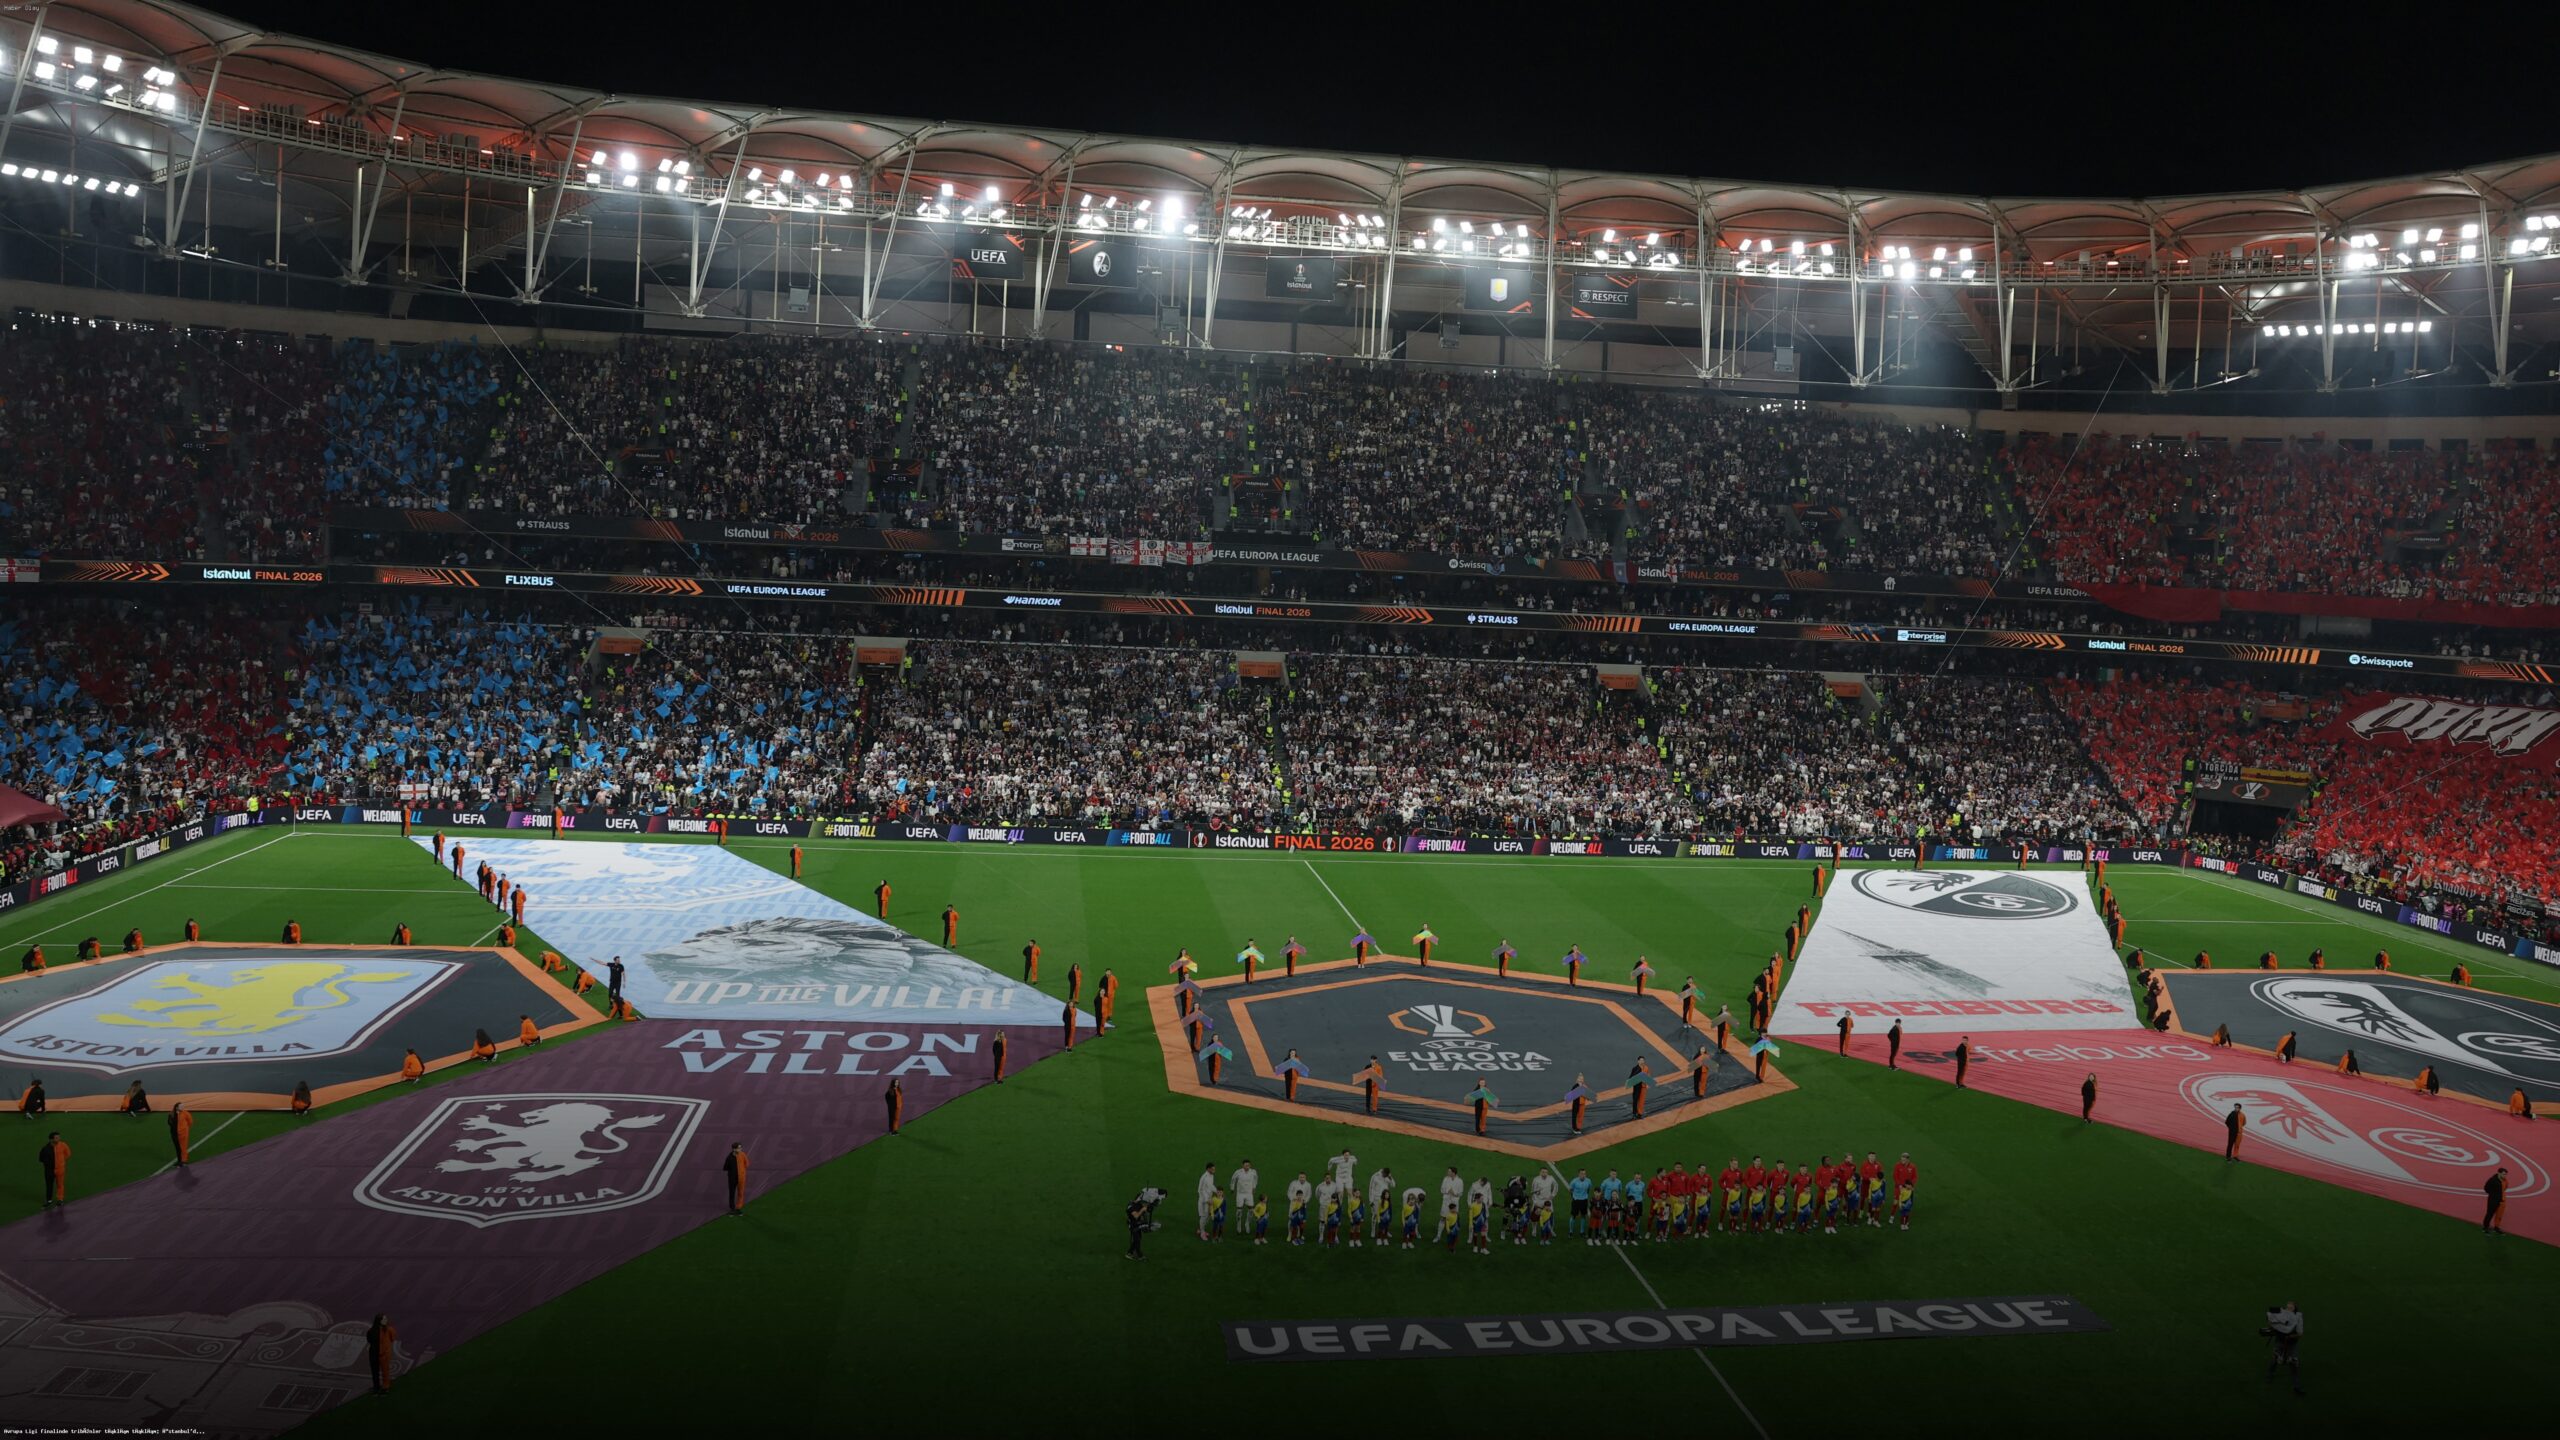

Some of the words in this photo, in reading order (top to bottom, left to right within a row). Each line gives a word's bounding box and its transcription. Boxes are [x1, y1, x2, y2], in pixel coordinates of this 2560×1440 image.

[971, 250, 1007, 264] UEFA
[1592, 292, 1629, 303] RESPECT
[527, 520, 570, 530] STRAUSS
[724, 526, 770, 540] Istanbul
[811, 532, 839, 542] 2026
[1240, 551, 1279, 561] EUROPA
[203, 568, 251, 581] Istanbul
[255, 571, 290, 582] FINAL
[293, 572, 323, 582] 2026
[1638, 566, 1667, 578] Istanb
[727, 585, 751, 595] UEFA
[753, 586, 790, 597] EUROPA
[2027, 587, 2052, 597] UEFA
[1215, 603, 1253, 616] Istanbul
[1256, 607, 1284, 616] FINAL
[1287, 608, 1311, 617] 2026
[1478, 614, 1518, 625] STRAUSS
[1669, 622, 1690, 631] UEFA
[1692, 623, 1723, 633] EUROPA
[2088, 639, 2126, 651] Istanbul
[2129, 643, 2157, 653] FINAL
[2160, 644, 2184, 654] 2026
[2361, 655, 2414, 669] Swissquote
[2205, 762, 2239, 775] TORCIDA
[222, 811, 264, 830] #FOOTBL
[295, 809, 332, 822] UEFA
[453, 813, 486, 826] UEFA
[522, 814, 576, 829] #FOOTALL
[605, 818, 639, 830] UEFA
[667, 819, 708, 833] WELCOME
[707, 820, 720, 833] AL
[755, 822, 789, 835] UEFA
[185, 825, 204, 843] UEFA
[824, 825, 876, 838] #FOOTBALL
[906, 827, 939, 839] UEFA
[967, 828, 1008, 842] WELCOME
[1007, 829, 1025, 842] ALL
[1054, 831, 1086, 843] UEFA
[1121, 832, 1172, 845] #FOOTBALL
[1215, 834, 1270, 849] Istanbul
[1274, 836, 1326, 850] FINAL
[1331, 837, 1375, 851] 2026
[135, 840, 161, 861] WELCOME
[159, 835, 171, 853] ALL
[1418, 839, 1467, 852] #FOOTBALL
[1493, 842, 1524, 853] UEFA
[1550, 842, 1586, 855] WELCOME
[1586, 843, 1603, 855] ALL
[1629, 844, 1658, 855] UEFA
[1689, 844, 1735, 857] #FOOTBALL
[1761, 846, 1789, 857] UEFA
[1815, 846, 1849, 858] WELCME
[1849, 846, 1864, 858] ALL
[1888, 847, 1916, 858] UEFA
[1945, 847, 1989, 860] #FOOTBALL
[2012, 850, 2040, 861] UFA
[2063, 849, 2095, 861] WELCE
[2095, 850, 2110, 862] ALL
[2133, 850, 2162, 862] UEFA
[97, 855, 119, 874] UEFA
[2193, 855, 2239, 876] #FOOTBALL
[39, 867, 79, 895] #FOOTBALL
[2257, 869, 2280, 885] UEFA
[2298, 879, 2326, 901] WELCOME
[2325, 884, 2338, 902] ALL
[2357, 896, 2383, 915] UEFA
[2409, 911, 2452, 936] #FOOTBALL
[2476, 930, 2506, 951] UEFA
[663, 982, 754, 1004] UP
[757, 987, 821, 1003] THE
[833, 984, 1014, 1011] VILLA!
[1795, 999, 2124, 1017] FREIBURG
[14, 1033, 161, 1058] ASTON
[174, 1040, 315, 1058] VILLA
[660, 1028, 981, 1054] ASTON
[1425, 1041, 1493, 1052] UEFA
[1387, 1051, 1552, 1062] EUROPA
[1974, 1043, 2212, 1064] freiburg
[680, 1051, 952, 1077] VILLA
[1408, 1061, 1546, 1073] LEAGUE
[389, 1185, 506, 1208] ASTON
[515, 1187, 625, 1208] VILLA
[484, 1186, 536, 1196] 1874
[1235, 1323, 1453, 1356] UEFA
[1463, 1314, 1778, 1350] EUROPA
